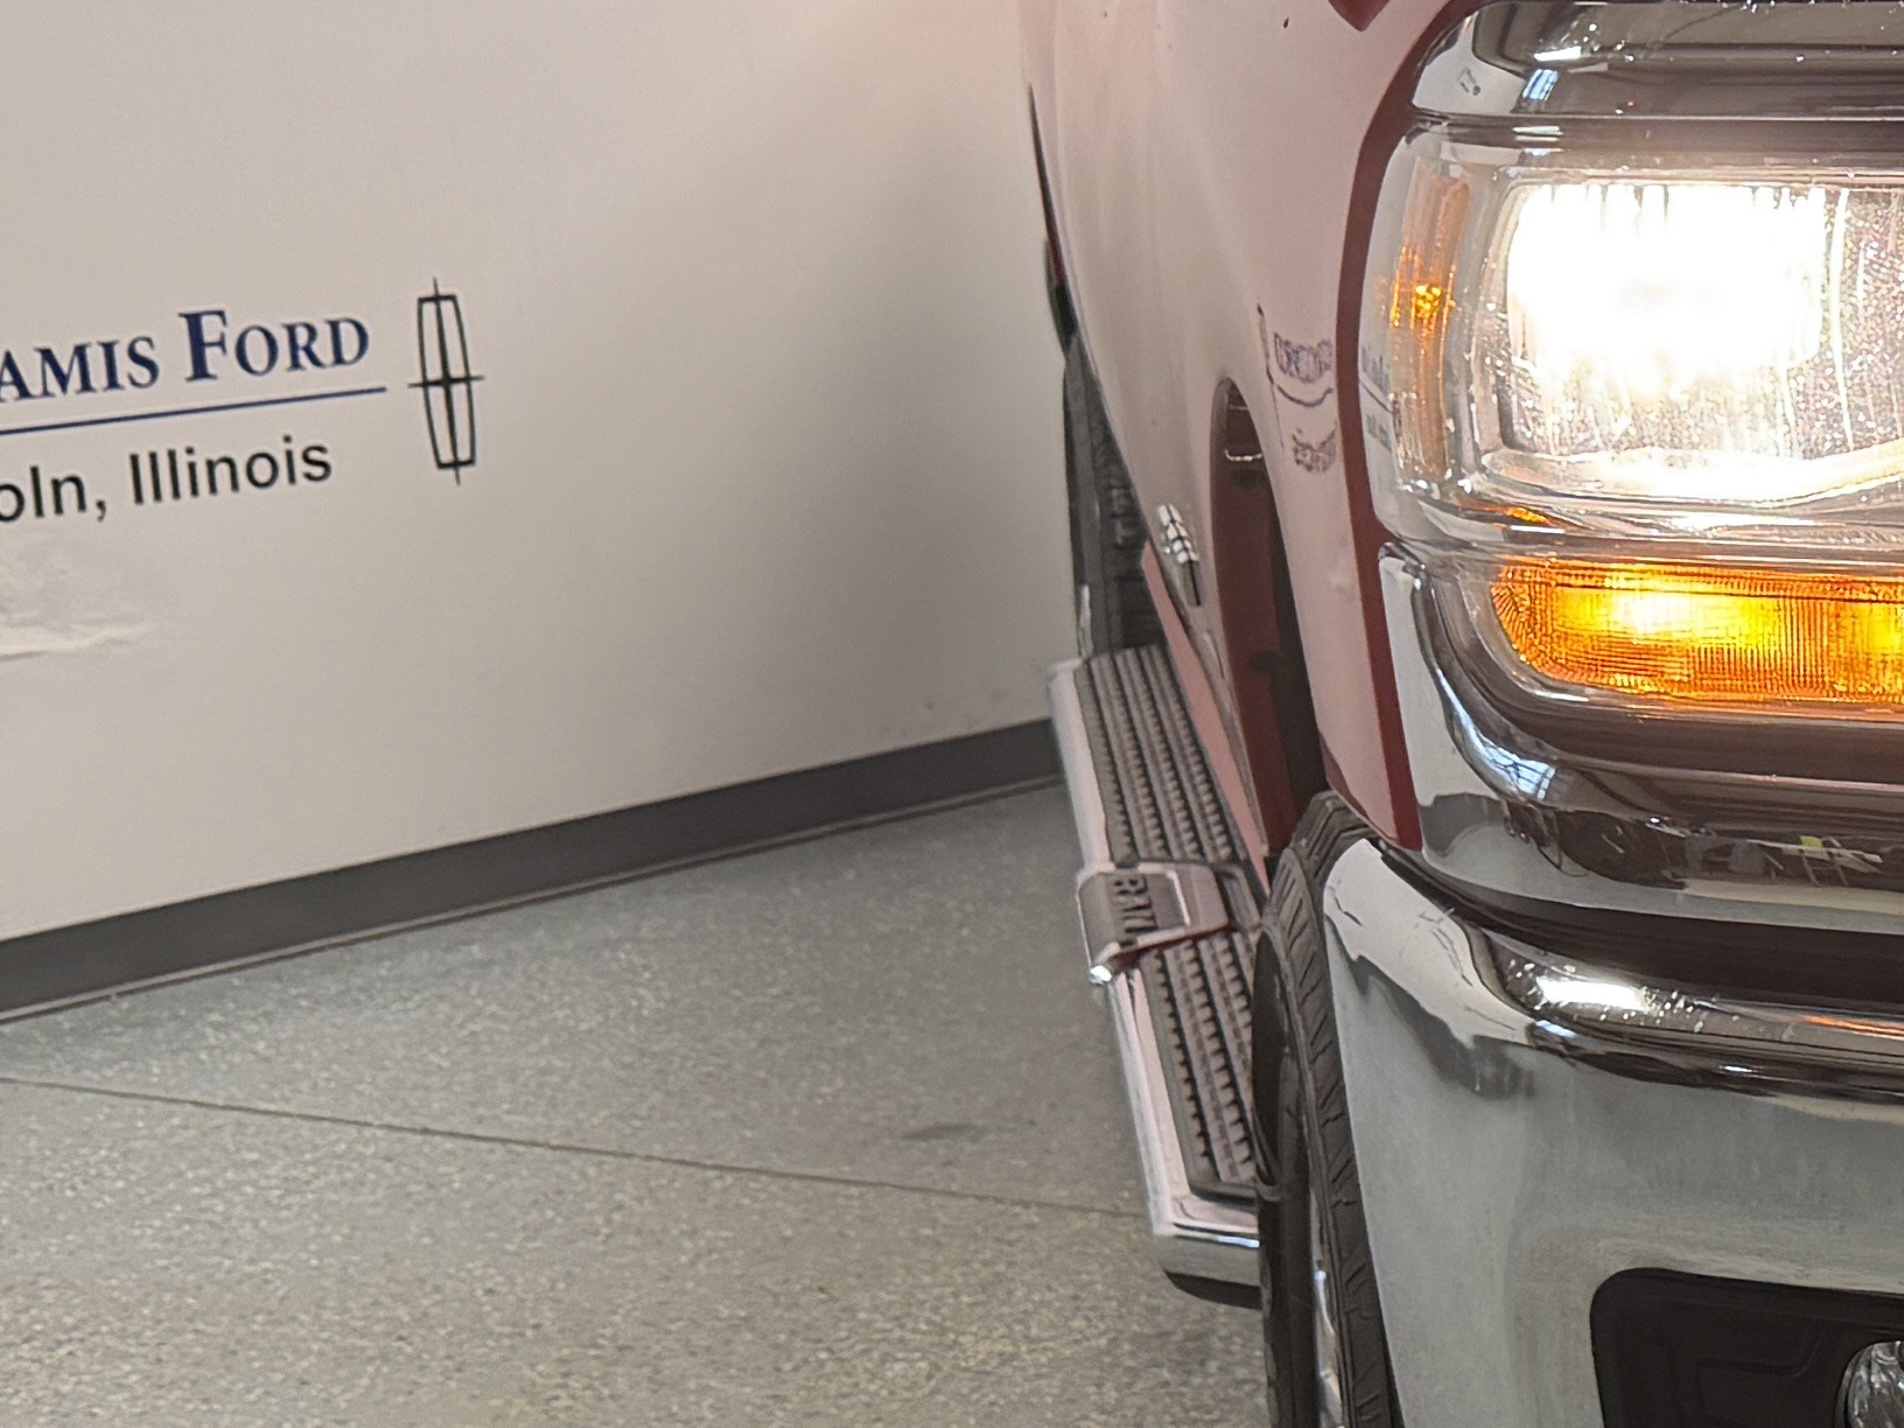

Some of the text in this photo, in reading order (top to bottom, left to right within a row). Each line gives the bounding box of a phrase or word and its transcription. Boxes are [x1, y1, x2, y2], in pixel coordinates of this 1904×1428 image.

[0, 309, 370, 403] AMIS FORD
[129, 435, 333, 507] Illinois
